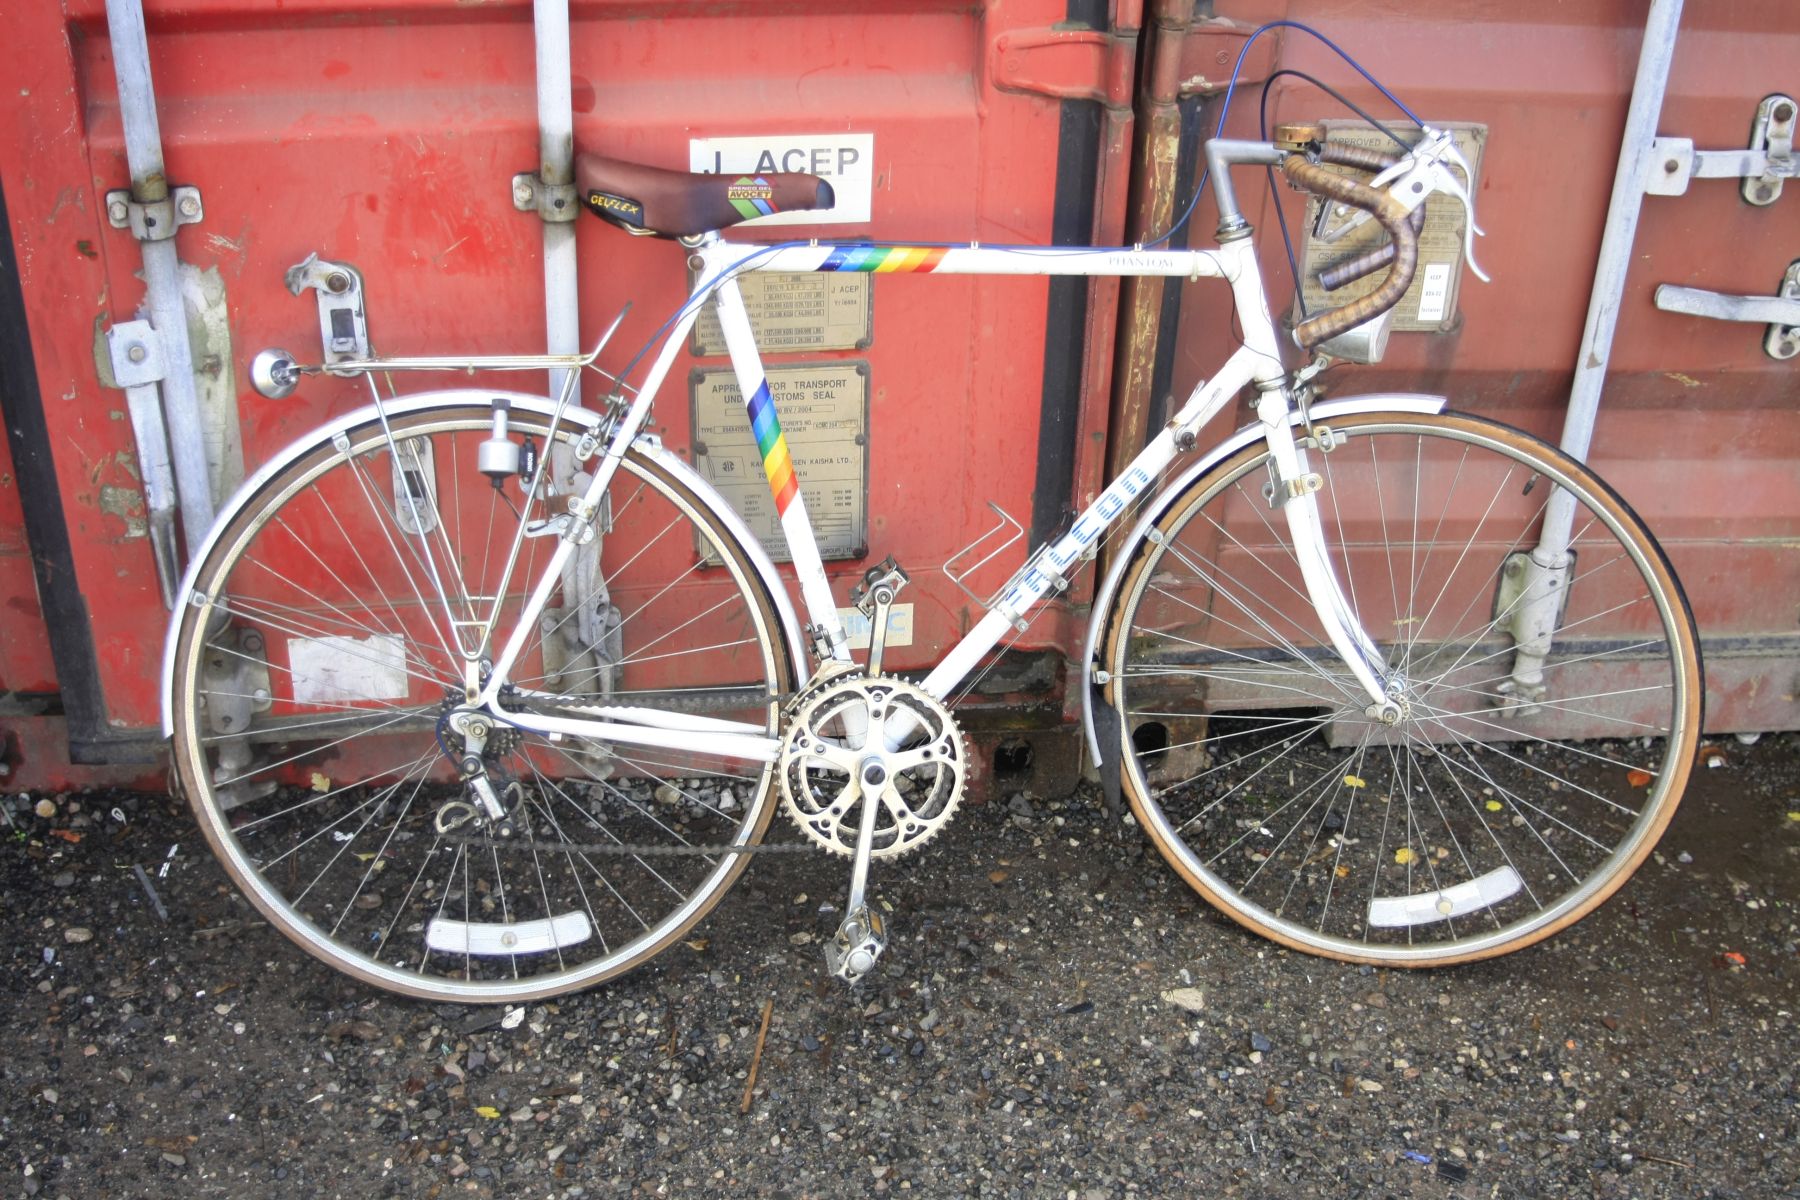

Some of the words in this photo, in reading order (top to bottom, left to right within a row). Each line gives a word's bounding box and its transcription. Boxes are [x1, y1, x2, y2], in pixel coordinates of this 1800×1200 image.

[704, 151, 722, 174] J
[754, 148, 860, 176] ACEP
[591, 194, 639, 215] GELFLEX
[1109, 256, 1173, 269] PHANTOM
[839, 285, 860, 294] ACEP
[794, 379, 848, 390] TRANSPORT
[812, 391, 836, 400] SEAL
[810, 457, 834, 465] KAISHA
